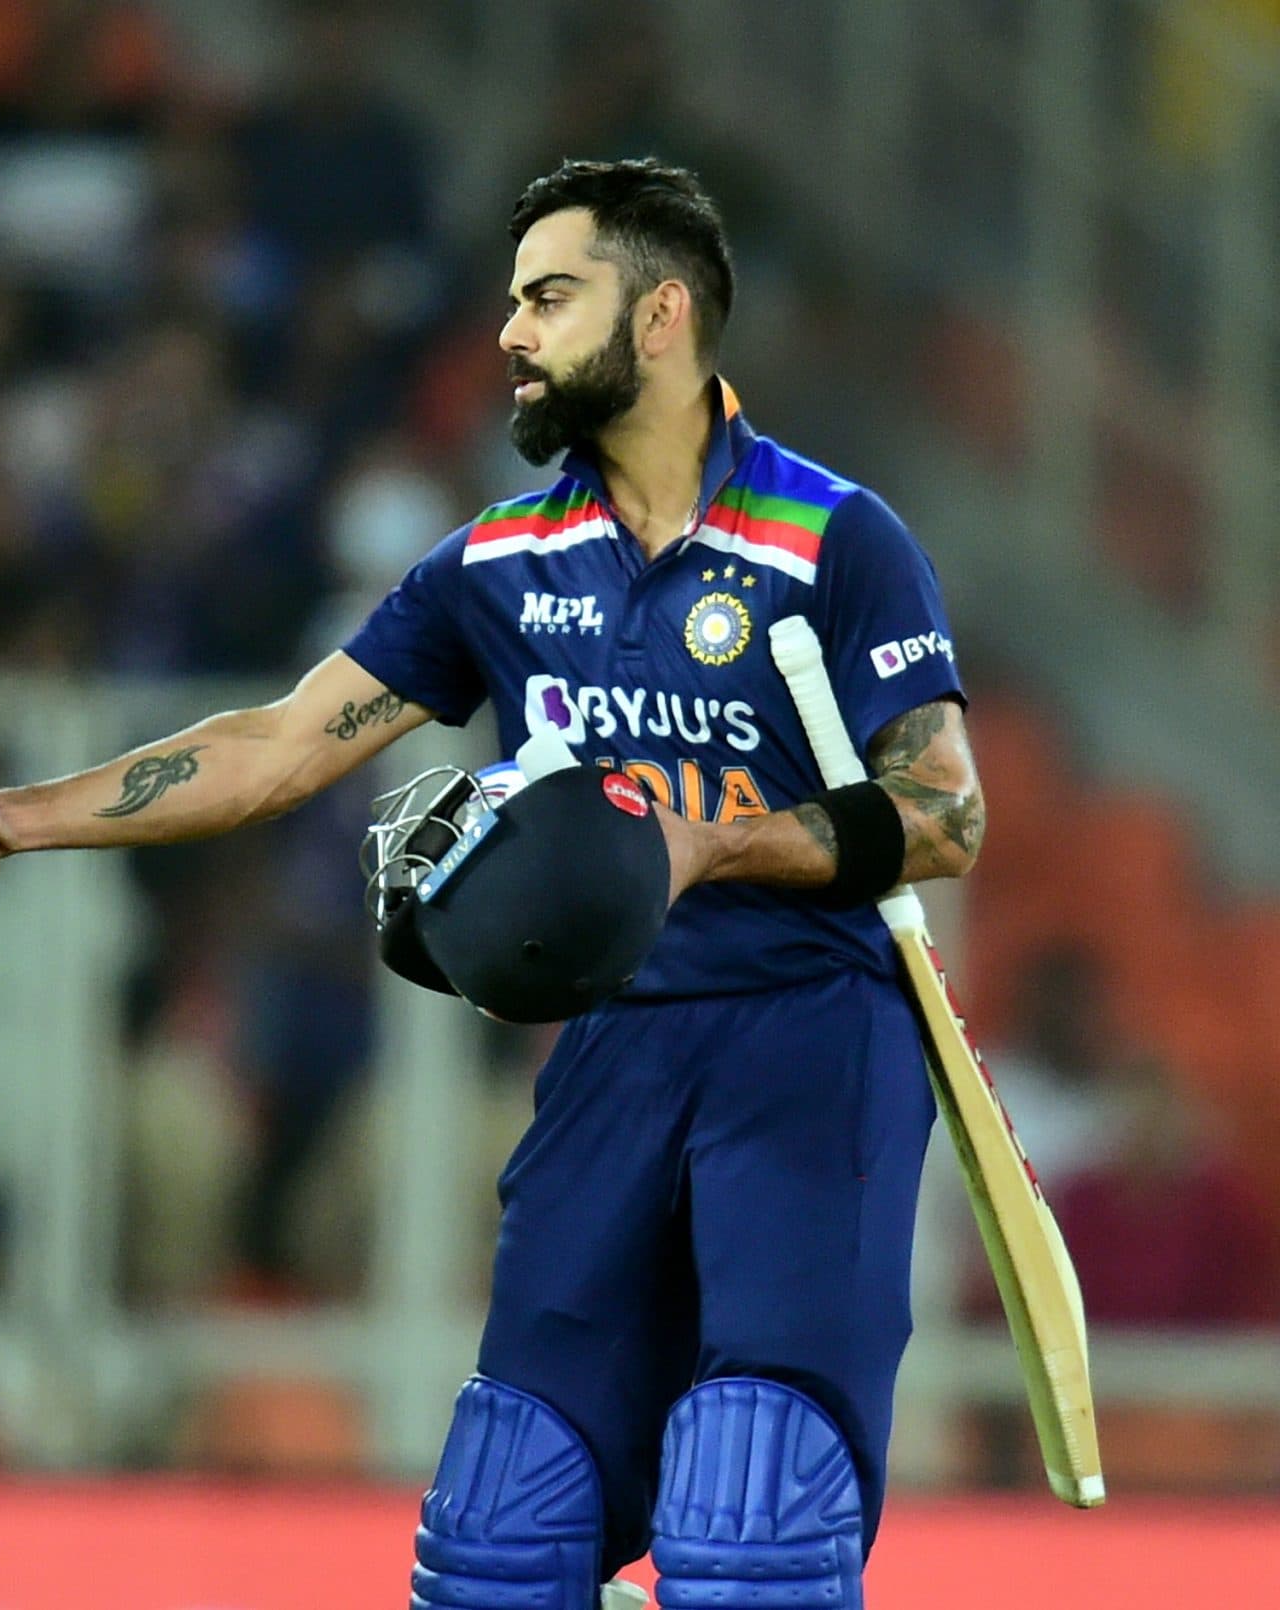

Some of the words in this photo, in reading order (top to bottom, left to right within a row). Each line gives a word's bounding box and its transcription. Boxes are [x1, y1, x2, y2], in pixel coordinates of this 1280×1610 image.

[519, 624, 602, 636] SPORTS
[520, 592, 604, 627] MPL
[578, 686, 761, 751] BYJU'S
[596, 757, 770, 825] DIA
